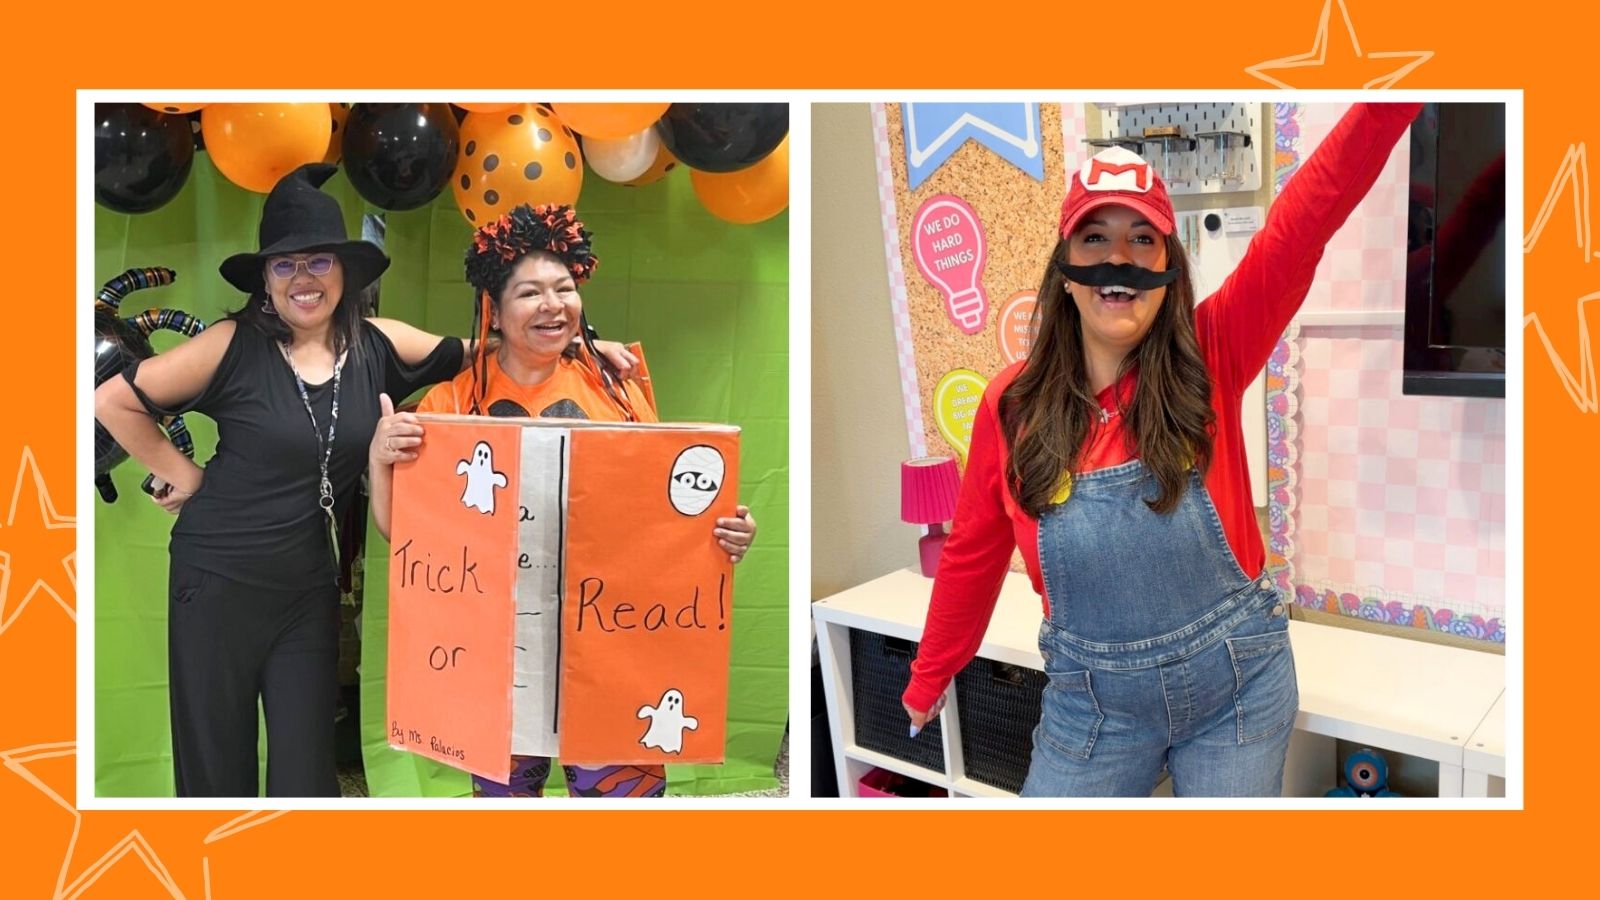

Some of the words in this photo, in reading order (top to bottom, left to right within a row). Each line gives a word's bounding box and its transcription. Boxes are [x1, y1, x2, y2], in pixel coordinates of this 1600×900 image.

[1087, 158, 1148, 190] M
[923, 219, 943, 236] WE
[943, 213, 961, 229] DO
[931, 232, 963, 253] HARD
[933, 248, 975, 272] THINGS
[1013, 311, 1028, 321] WE
[395, 539, 484, 594] Trick
[577, 573, 727, 633] Read!
[429, 646, 467, 671] or
[391, 720, 404, 745] By
[430, 736, 465, 760] Palacios
